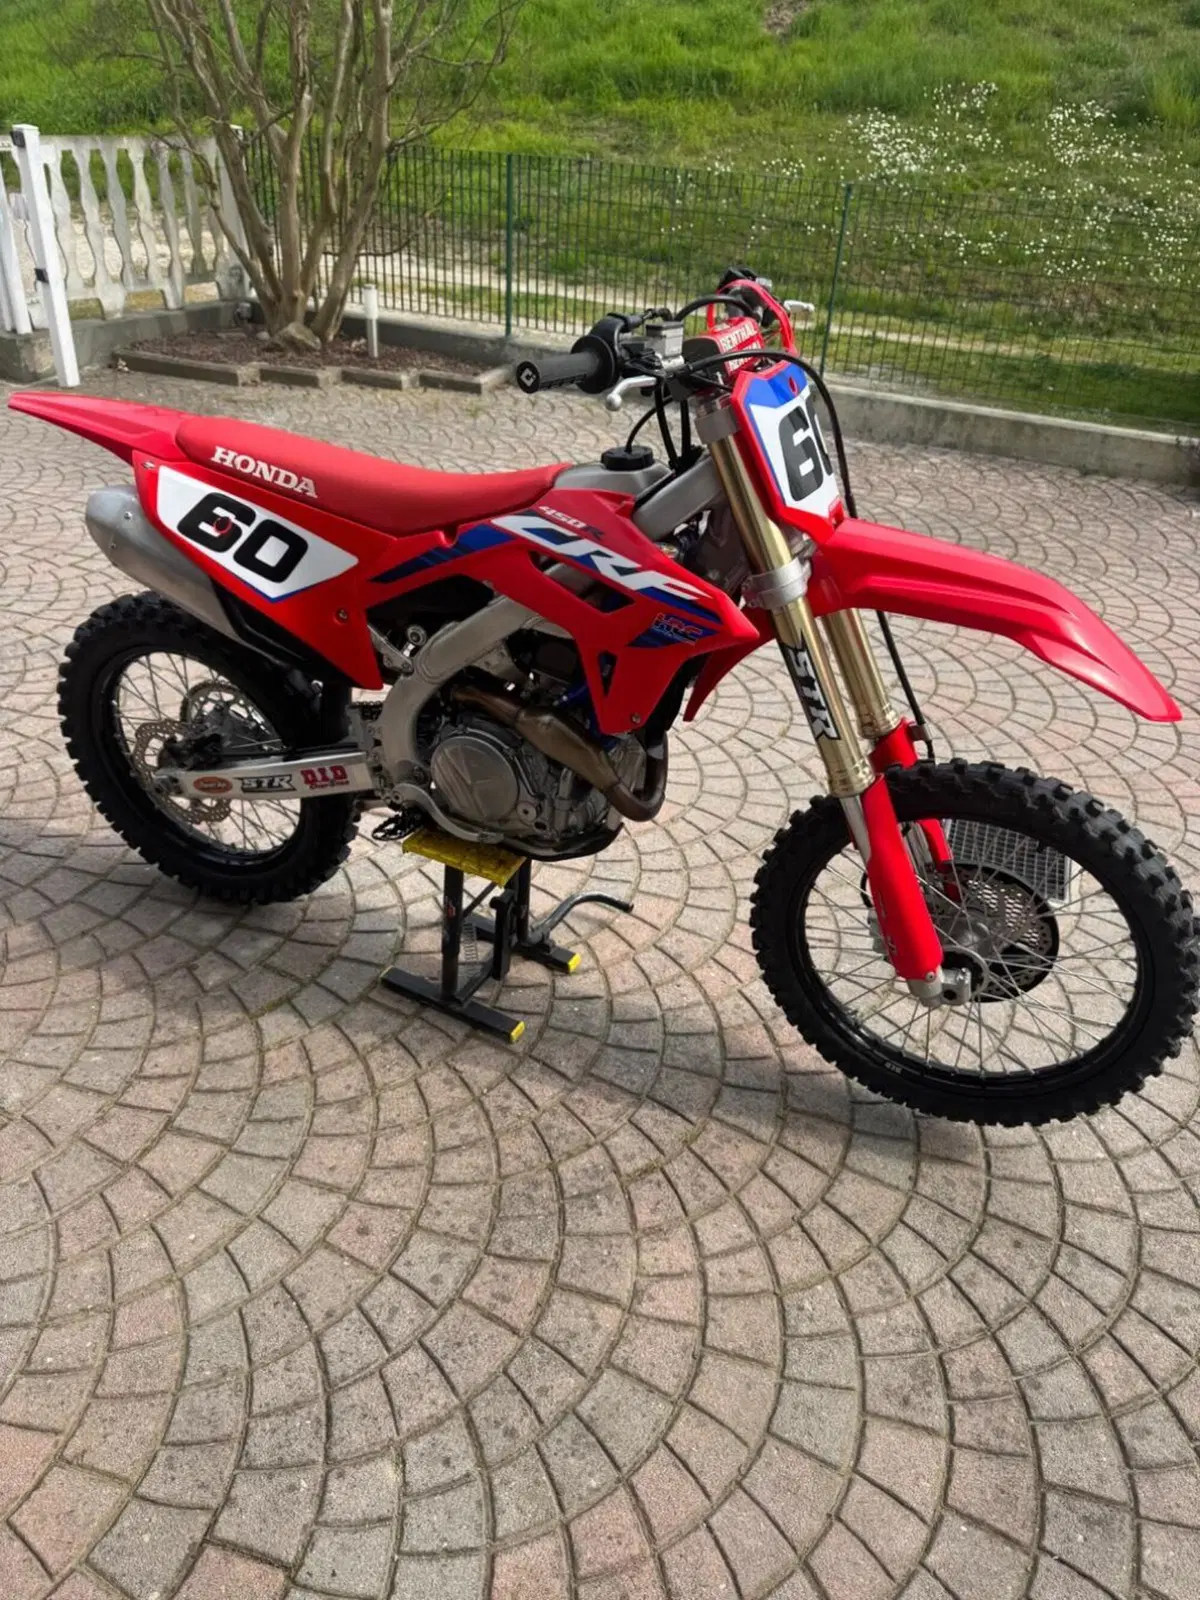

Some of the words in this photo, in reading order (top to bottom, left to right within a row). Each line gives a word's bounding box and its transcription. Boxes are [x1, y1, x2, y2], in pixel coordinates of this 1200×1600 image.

[211, 446, 318, 498] HONDA
[177, 492, 308, 583] 60
[240, 774, 296, 791] STR
